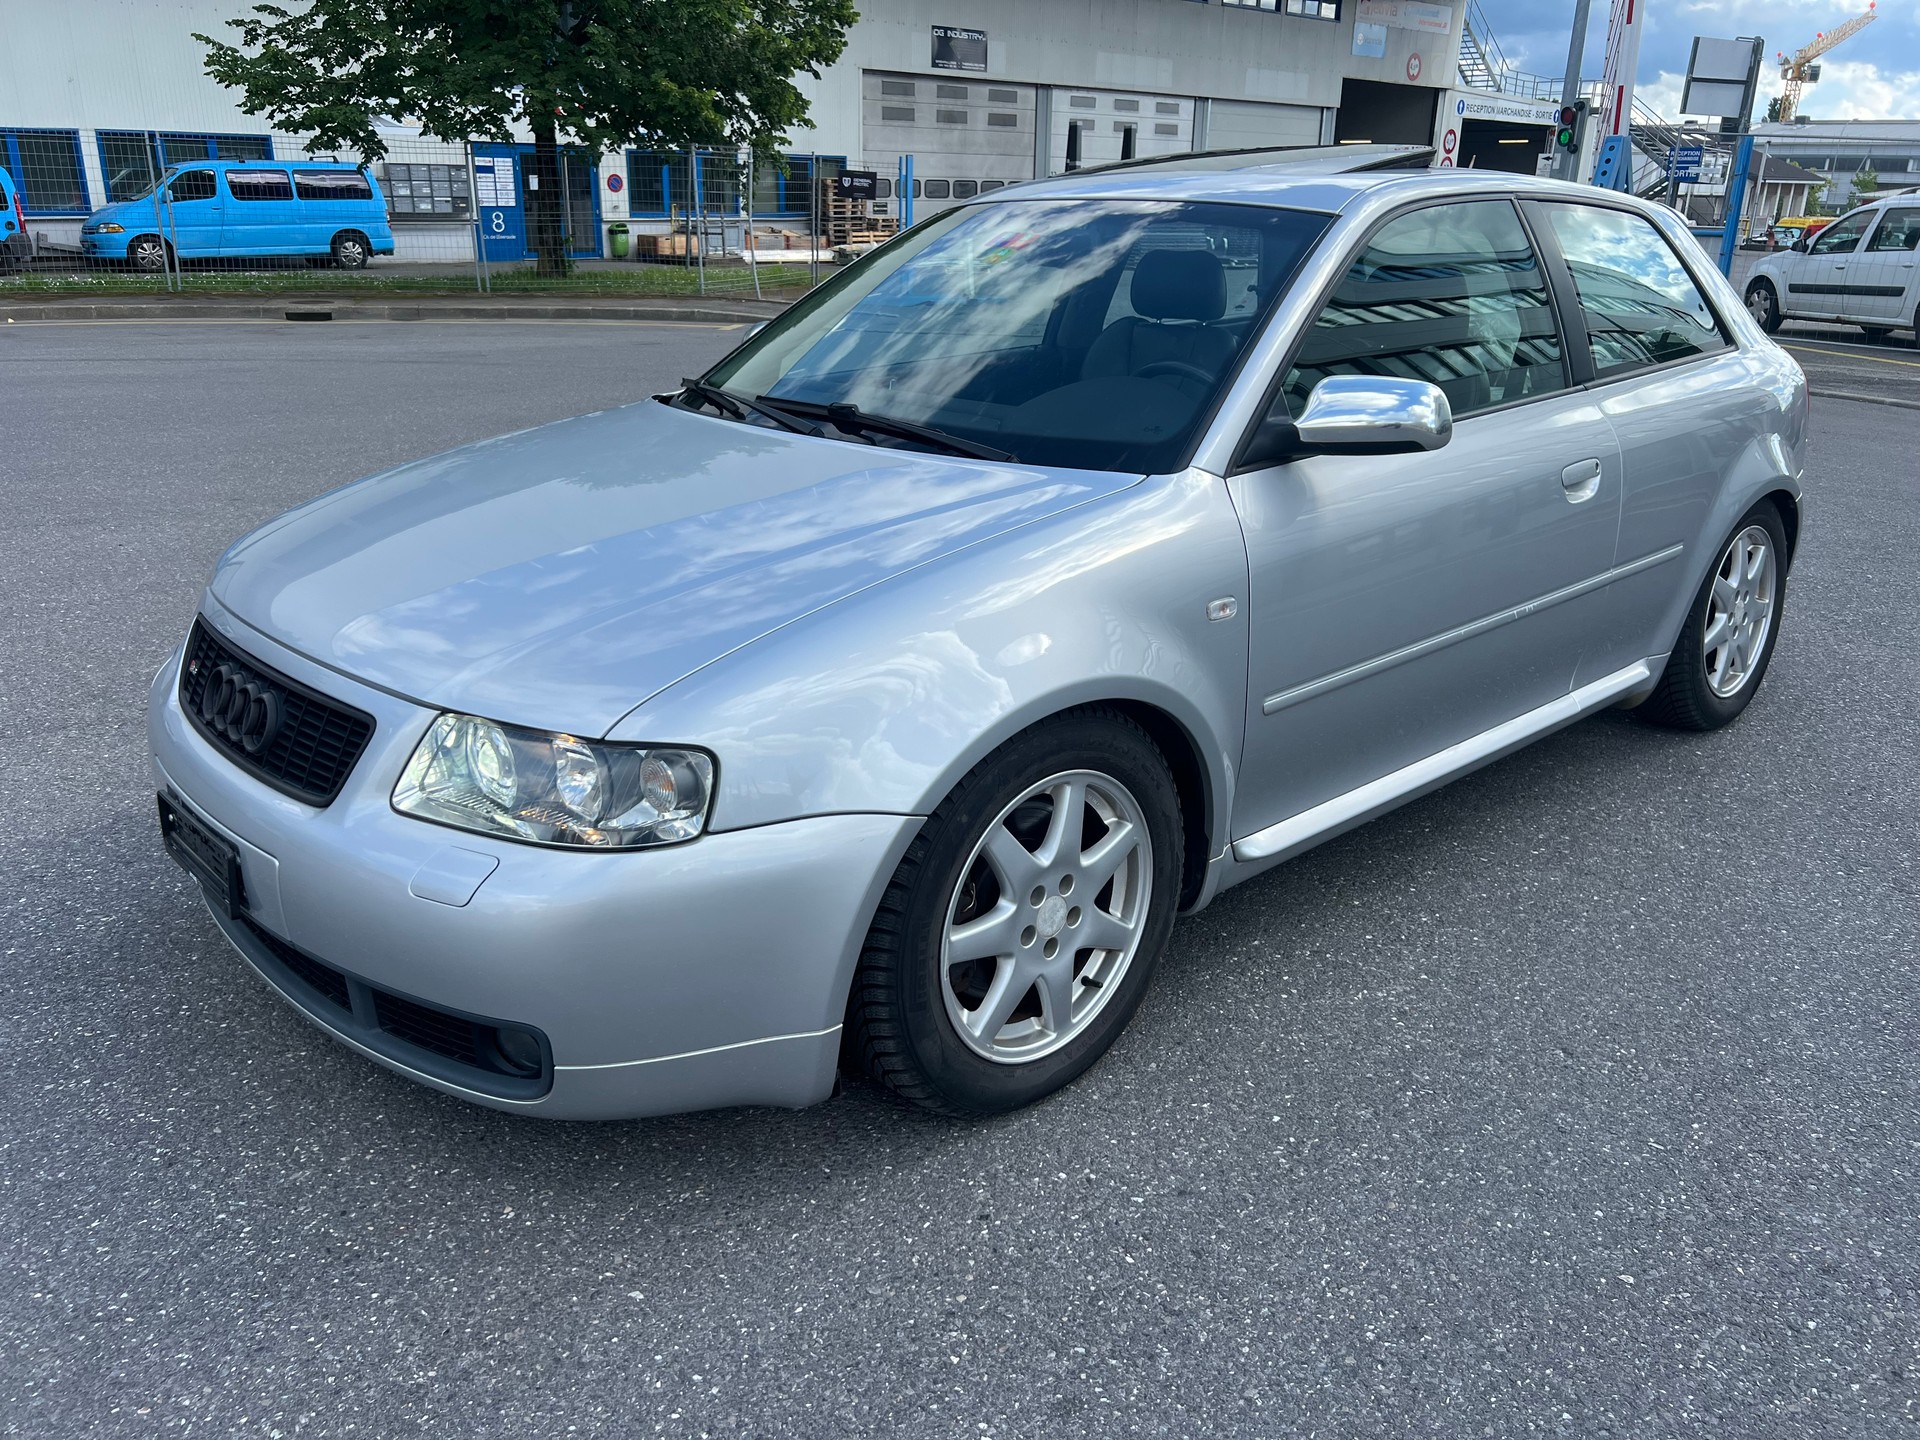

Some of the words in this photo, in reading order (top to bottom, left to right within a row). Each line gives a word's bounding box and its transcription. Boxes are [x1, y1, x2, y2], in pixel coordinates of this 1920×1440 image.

[1466, 103, 1495, 114] RECEPTION
[1535, 110, 1553, 120] SORTIE
[492, 211, 505, 232] 8
